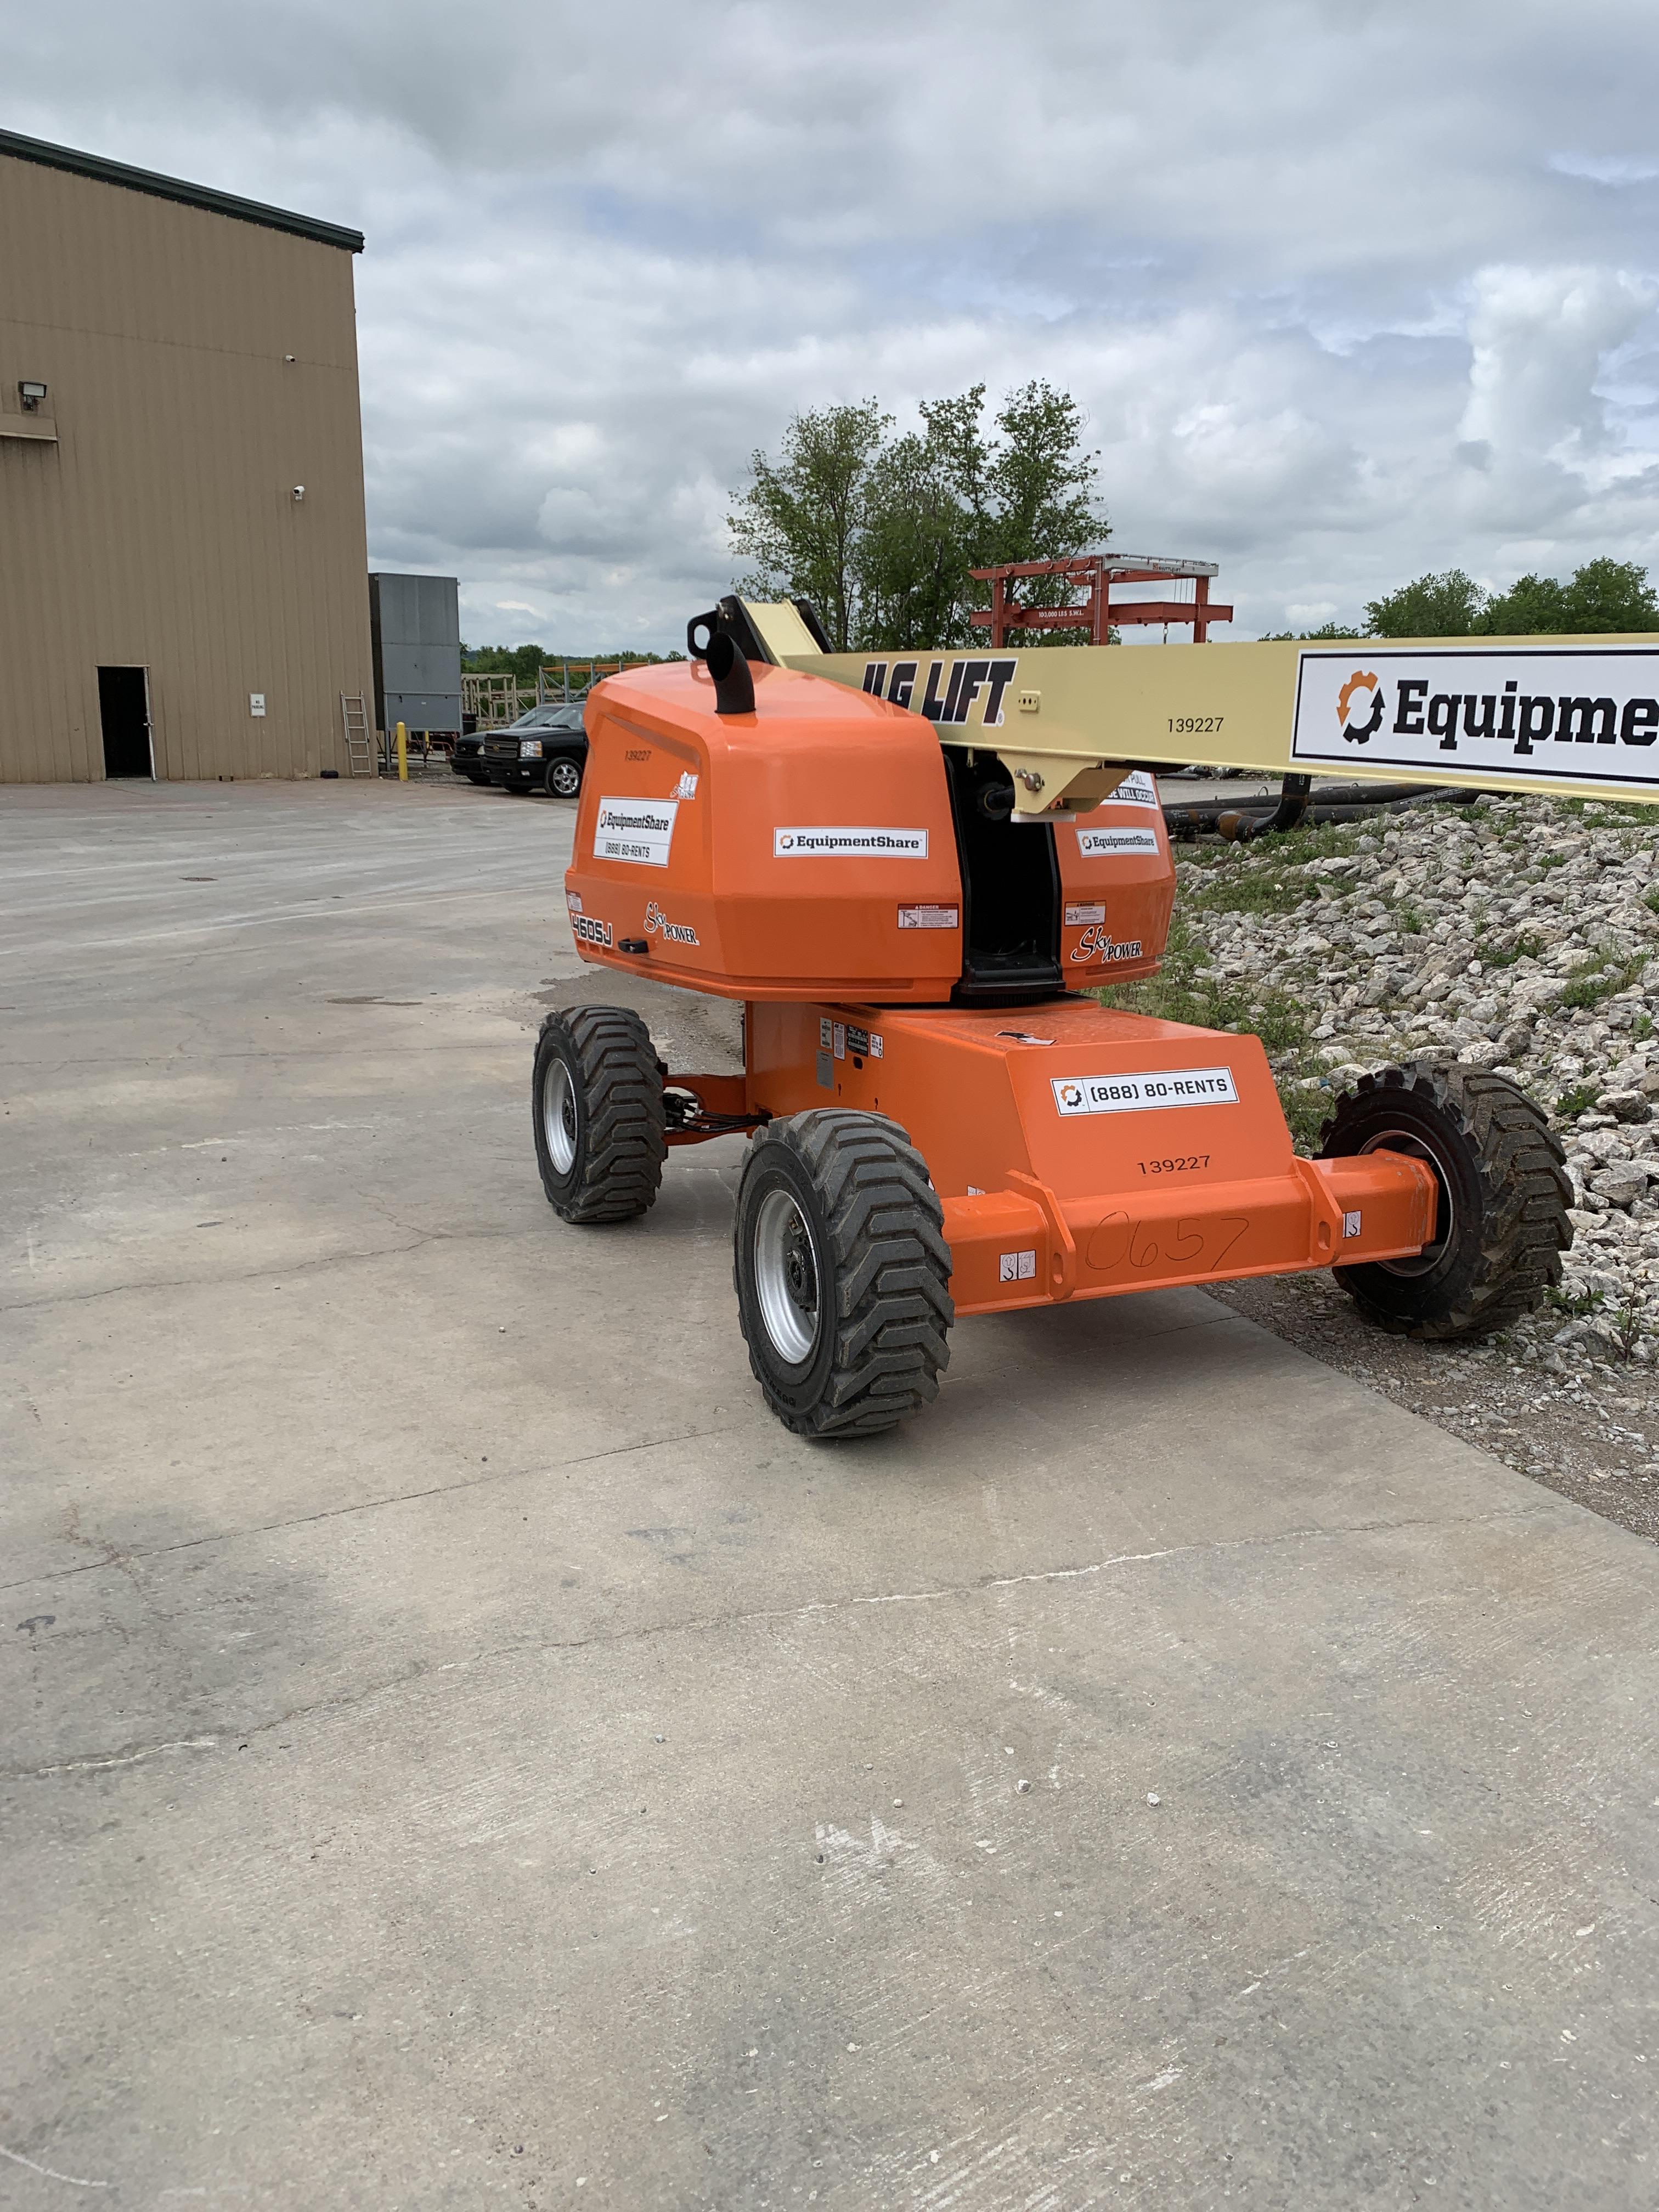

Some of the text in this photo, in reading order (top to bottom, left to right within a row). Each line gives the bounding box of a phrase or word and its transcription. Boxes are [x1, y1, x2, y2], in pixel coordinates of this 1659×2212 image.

[922, 659, 1018, 726] LIFT
[1167, 717, 1224, 733] 139227
[1393, 680, 1659, 754] Equipme
[624, 751, 652, 761] 139227
[1118, 788, 1136, 799] WILL
[607, 812, 669, 831] EquipmentShare
[797, 834, 919, 849] EquipmentShare
[1093, 835, 1154, 849] EquipmentShare
[665, 924, 697, 944] POWER
[1108, 941, 1142, 961] POWER
[1091, 1077, 1228, 1102] (888) 80-RENTS
[1137, 1155, 1211, 1176] 139227
